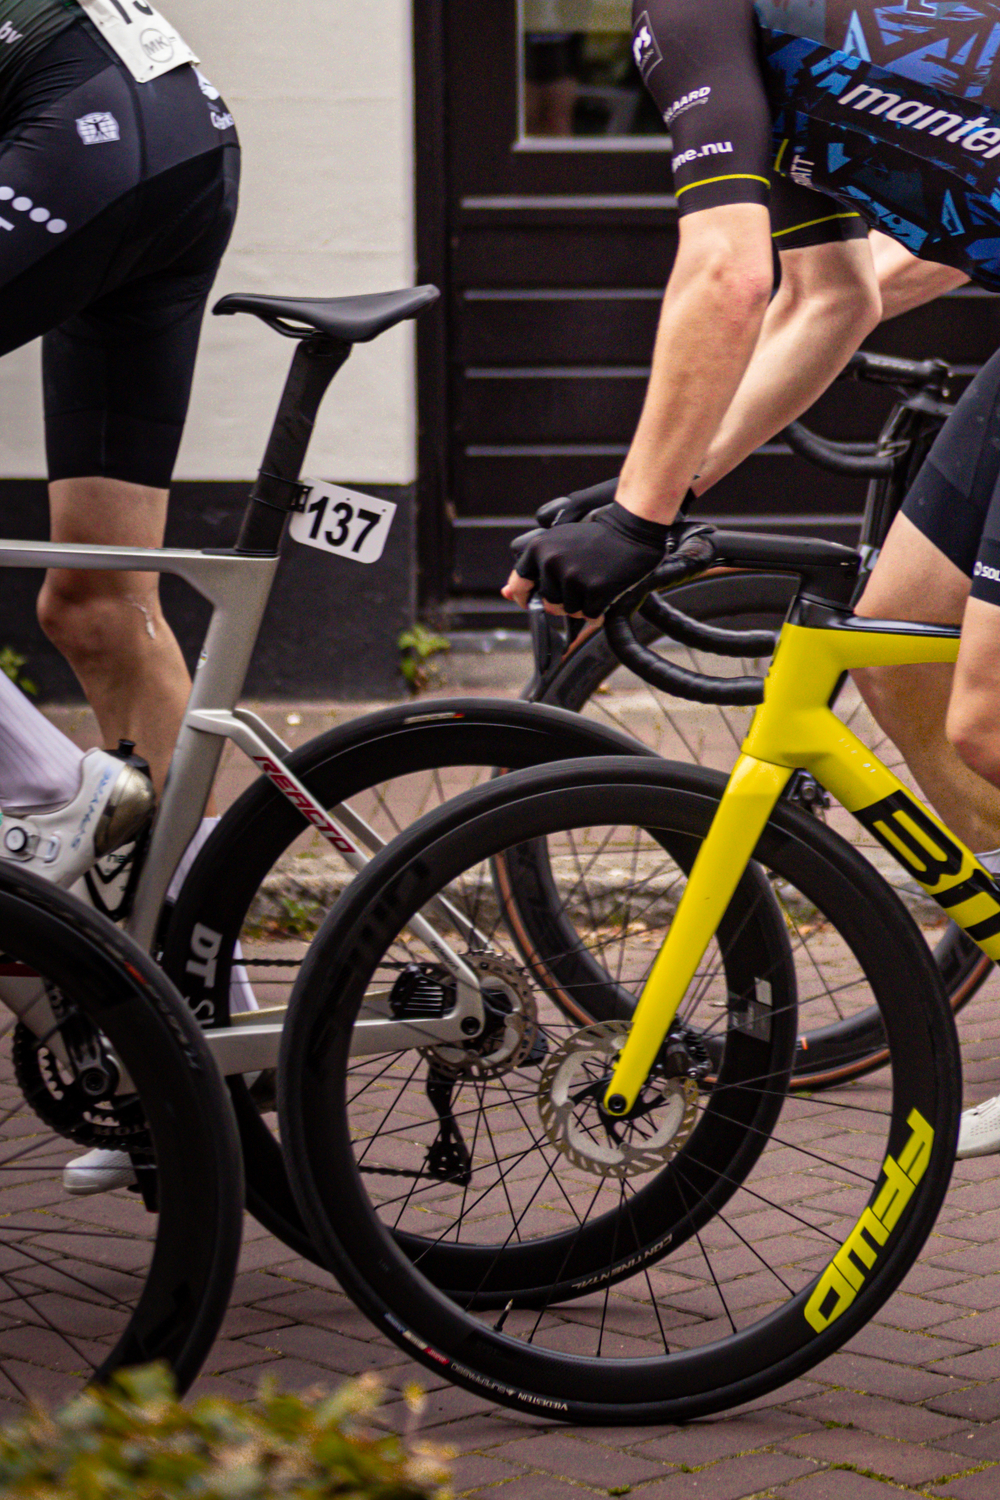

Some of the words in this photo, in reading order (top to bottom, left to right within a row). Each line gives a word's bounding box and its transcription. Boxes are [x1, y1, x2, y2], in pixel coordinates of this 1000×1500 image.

[308, 495, 383, 554] 137
[252, 755, 356, 854] REACTO
[185, 921, 223, 989] DT
[803, 1106, 936, 1335] FFWD
[570, 1232, 674, 1290] CONTINENTAL
